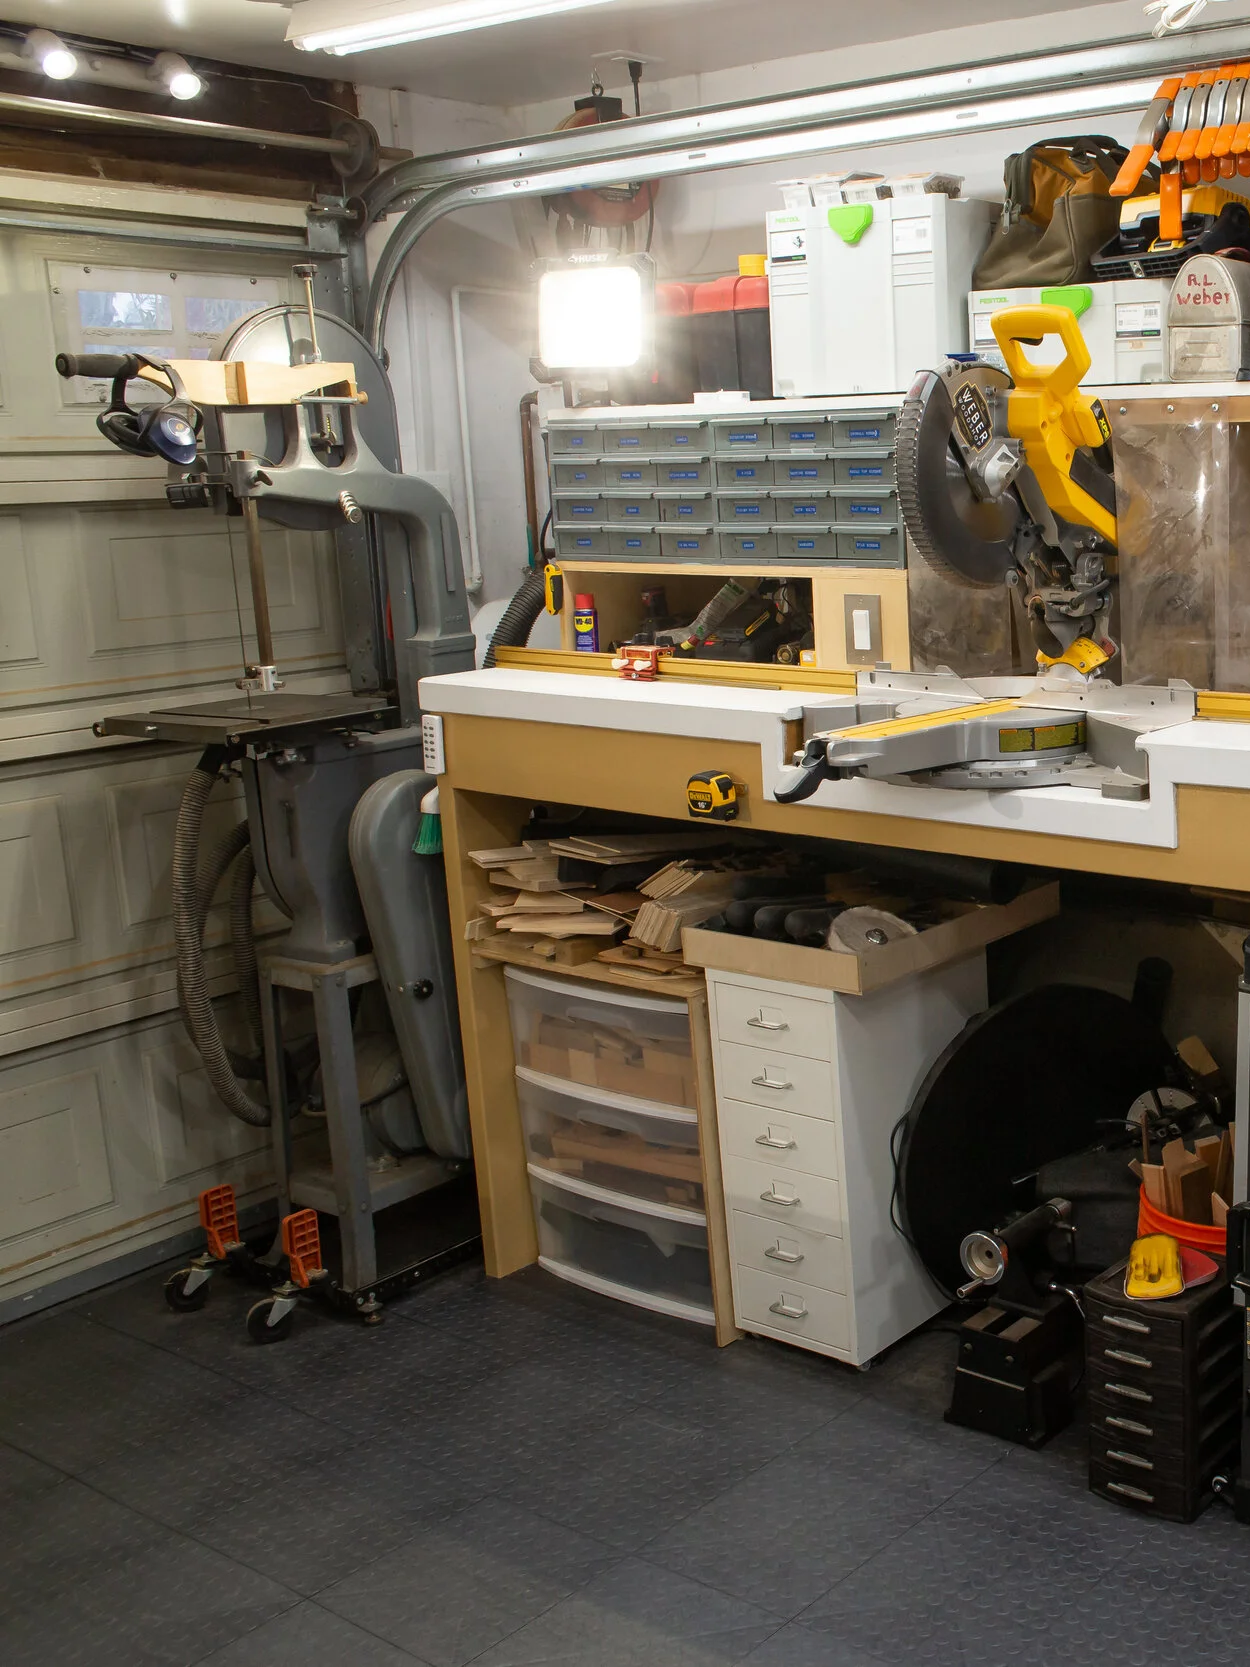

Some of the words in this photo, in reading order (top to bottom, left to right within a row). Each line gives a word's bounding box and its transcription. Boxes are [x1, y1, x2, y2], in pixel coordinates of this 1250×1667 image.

[578, 252, 608, 262] HUSKY
[958, 397, 982, 446] WOODSHOP
[962, 388, 988, 445] WEBER
